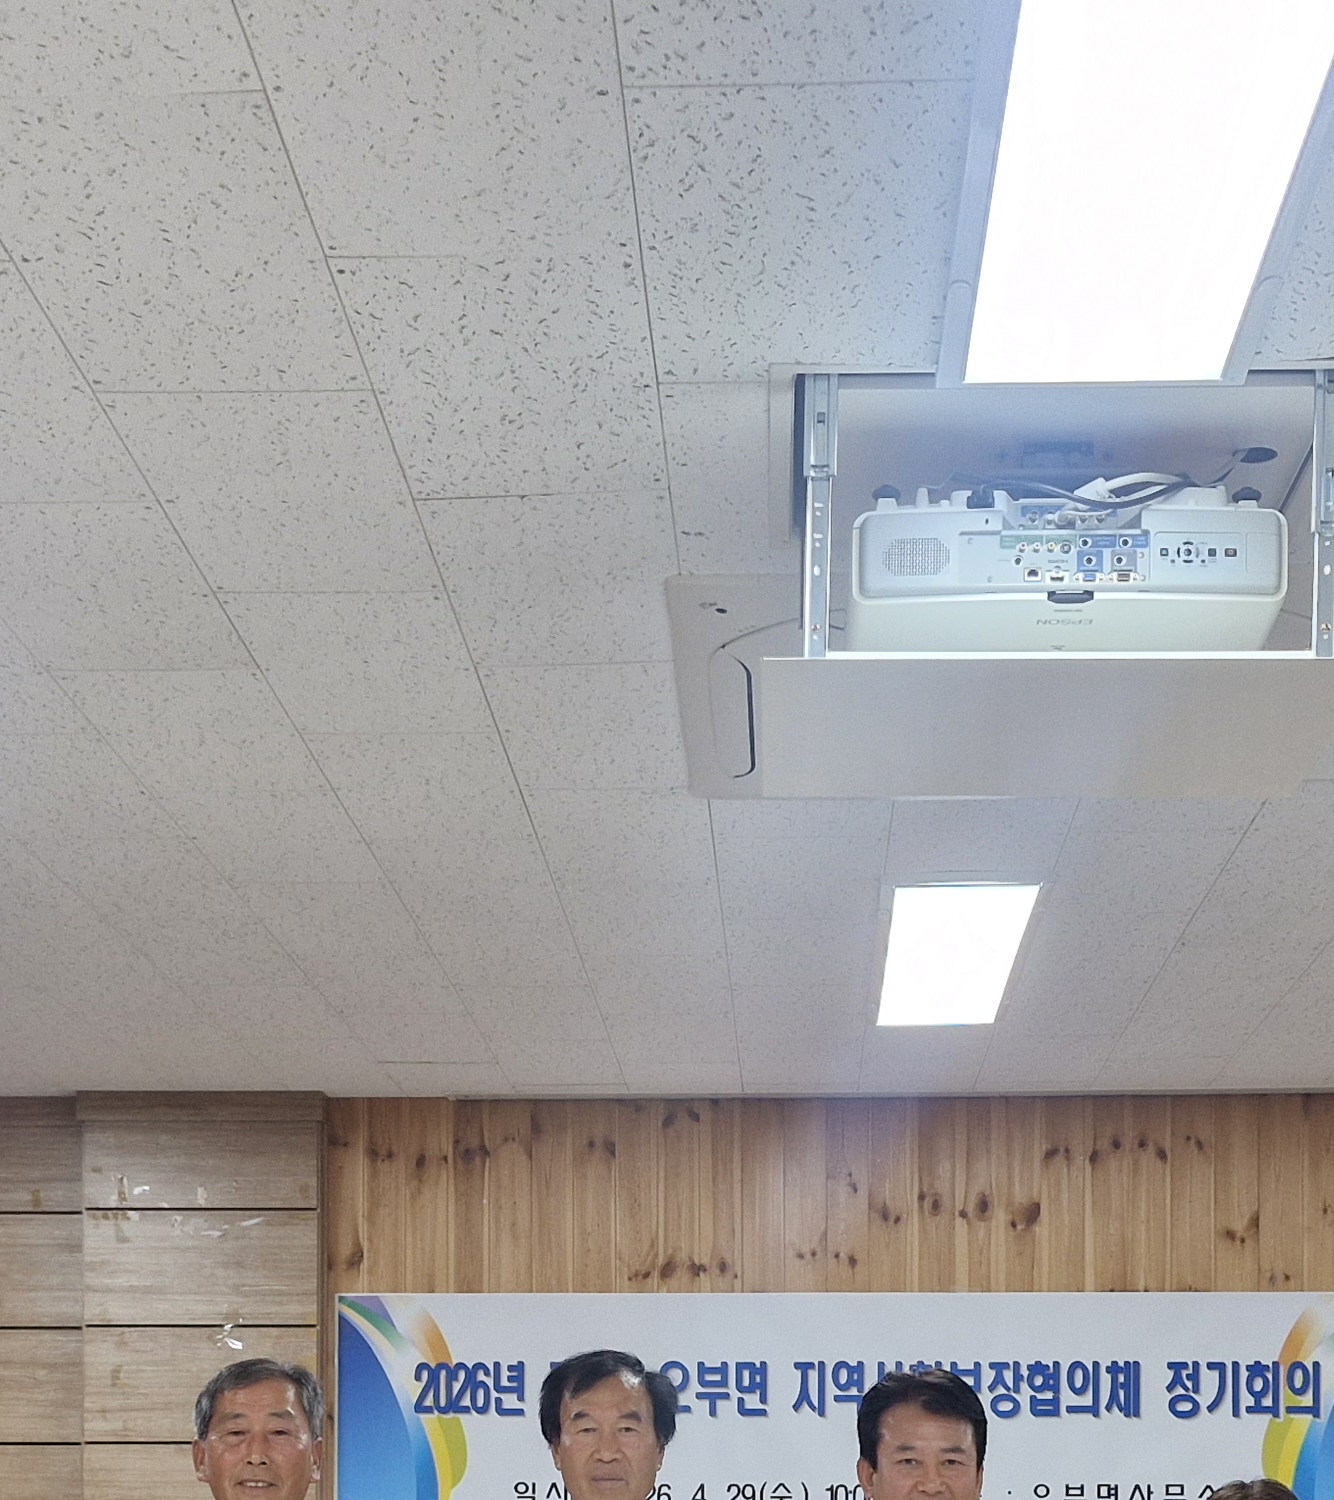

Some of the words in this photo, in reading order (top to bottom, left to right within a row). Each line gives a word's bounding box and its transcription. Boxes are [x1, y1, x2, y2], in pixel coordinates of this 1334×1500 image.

[1036, 618, 1094, 626] EPSON
[414, 1360, 525, 1417] 2026년
[659, 1360, 768, 1417] 오부면
[792, 1360, 1141, 1419] 지역장협의체
[1165, 1360, 1322, 1419] 정기회의
